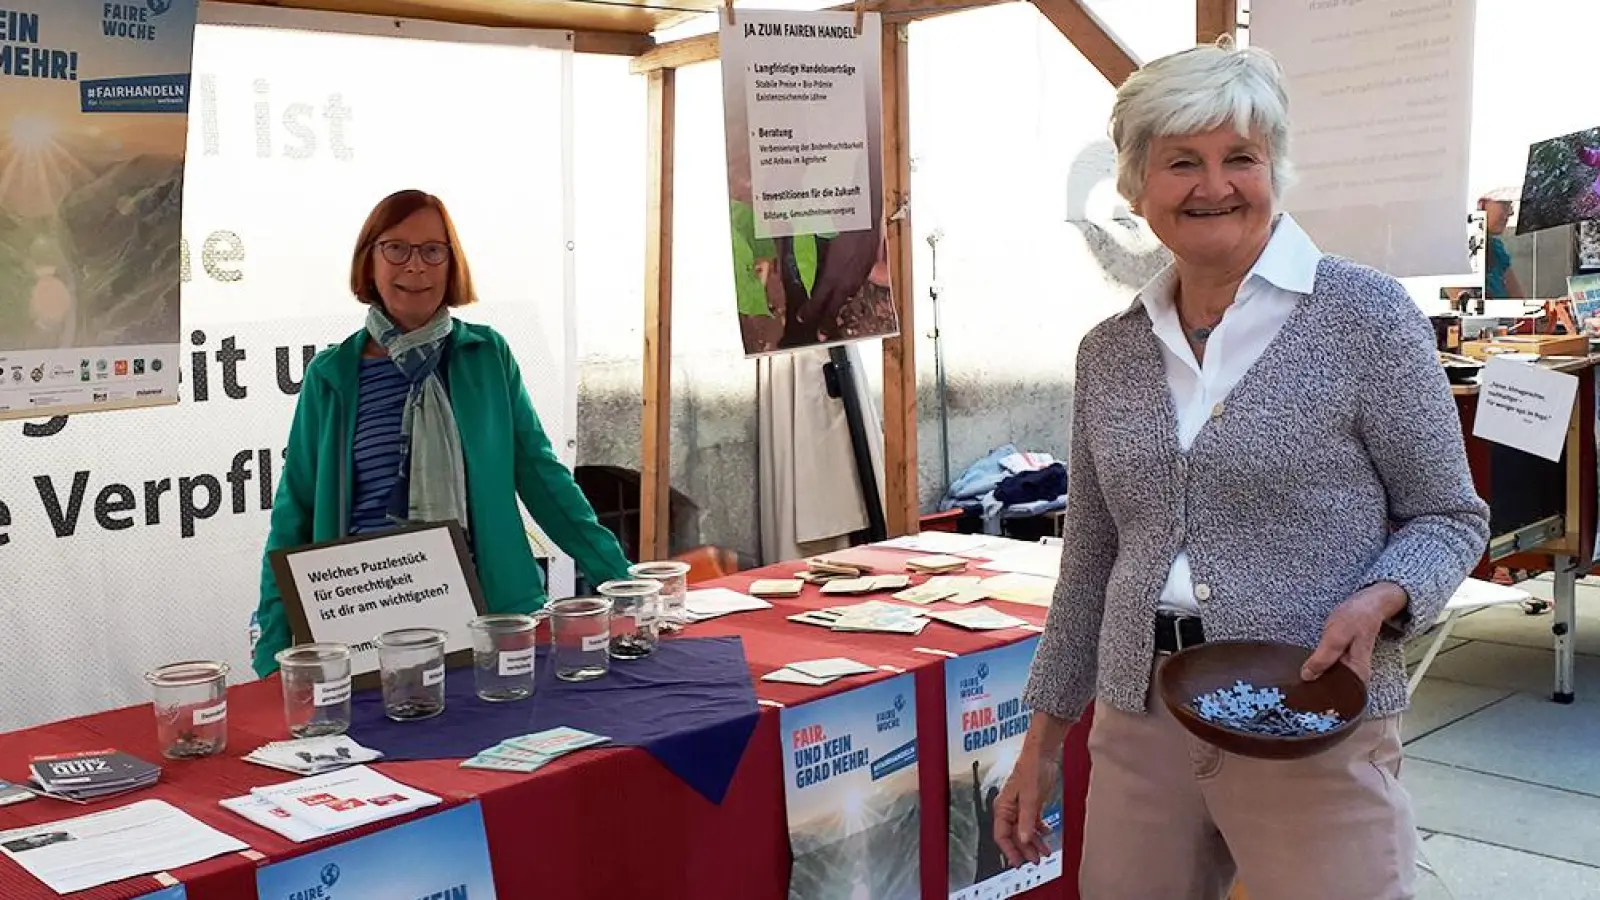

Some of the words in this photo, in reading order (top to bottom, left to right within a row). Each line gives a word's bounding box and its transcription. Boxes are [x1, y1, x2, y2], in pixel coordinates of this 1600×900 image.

[104, 3, 148, 22] FAIRE
[103, 21, 156, 40] WOCHE
[744, 23, 756, 38] JA
[758, 23, 783, 36] ZUM
[784, 23, 816, 38] FAIREN
[754, 62, 799, 76] Langfristige
[87, 85, 185, 98] #FAIRHANDELN
[251, 77, 355, 161] ist
[758, 128, 794, 139] Beratung
[760, 157, 773, 166] und
[762, 190, 809, 201] Investitionen
[811, 187, 822, 199] für
[822, 187, 834, 197] die
[834, 185, 861, 197] Zukunft
[33, 447, 288, 539] Verpfl
[307, 565, 360, 584] Welches
[361, 551, 428, 573] Puzzlestück
[313, 589, 333, 602] für
[335, 573, 414, 598] Gerechtigkeit
[319, 606, 336, 620] ist
[338, 603, 355, 616] dir
[358, 600, 378, 614] am
[379, 583, 450, 608] wichtigsten?
[962, 707, 996, 732] FAIR.
[997, 697, 1019, 721] UND
[792, 724, 827, 749] FAIR.
[964, 726, 998, 752] GRAD
[794, 745, 822, 769] UND
[823, 734, 852, 760] KEIN
[796, 762, 830, 789] GRAD
[832, 747, 869, 776] MEHR!
